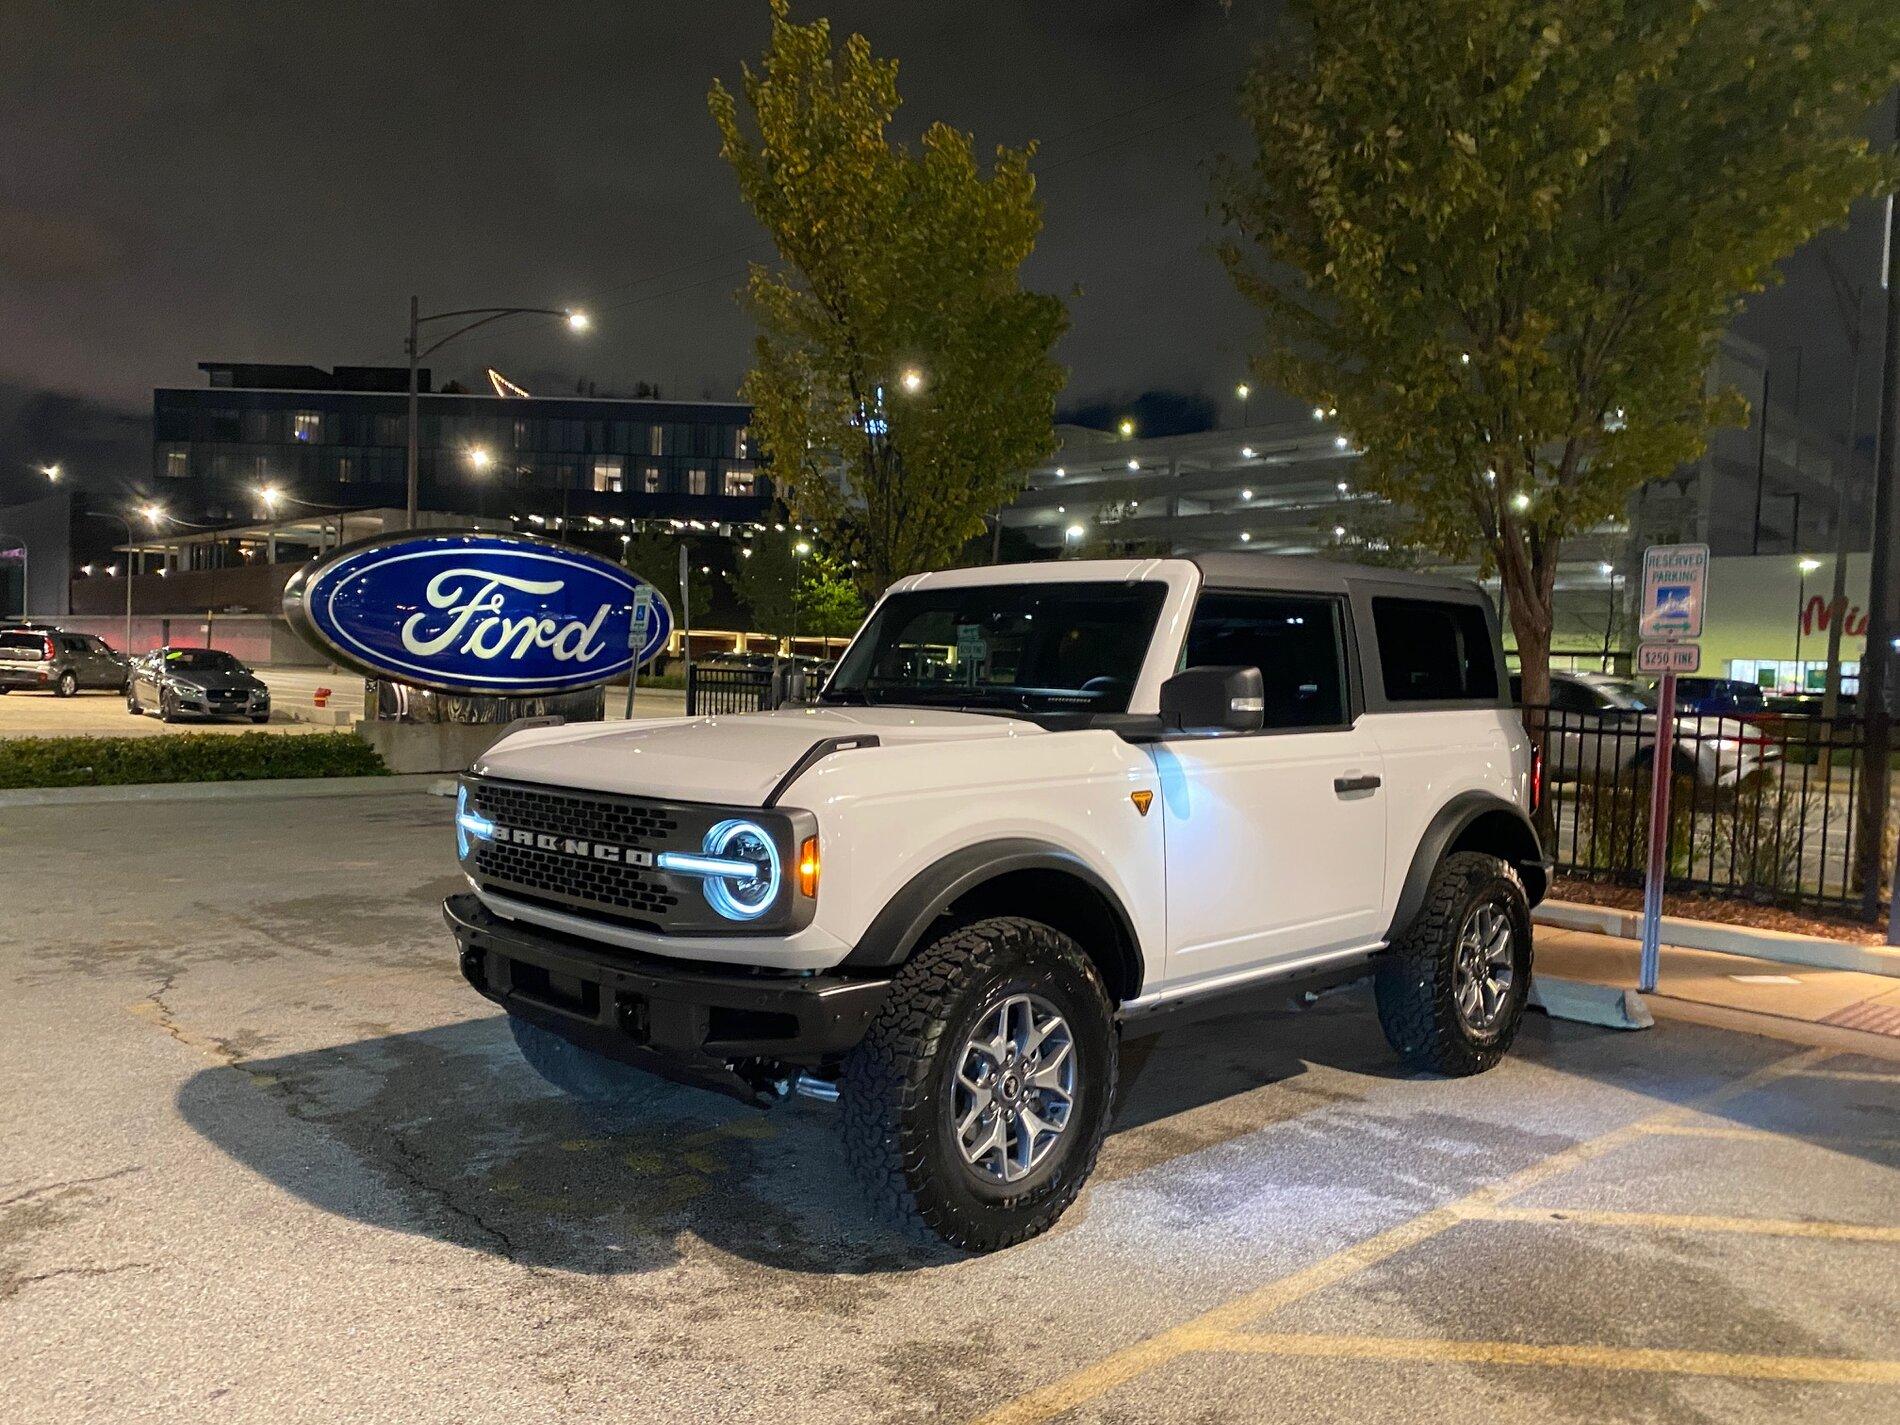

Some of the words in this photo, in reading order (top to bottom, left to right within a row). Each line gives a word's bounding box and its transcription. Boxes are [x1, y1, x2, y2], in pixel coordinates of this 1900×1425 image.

[1648, 553, 1703, 568] RESERVED
[1652, 570, 1696, 584] PARKING
[402, 568, 612, 662] Ford
[1645, 651, 1669, 666] $250
[1674, 651, 1693, 665] FINE
[491, 826, 653, 867] BRONCO
